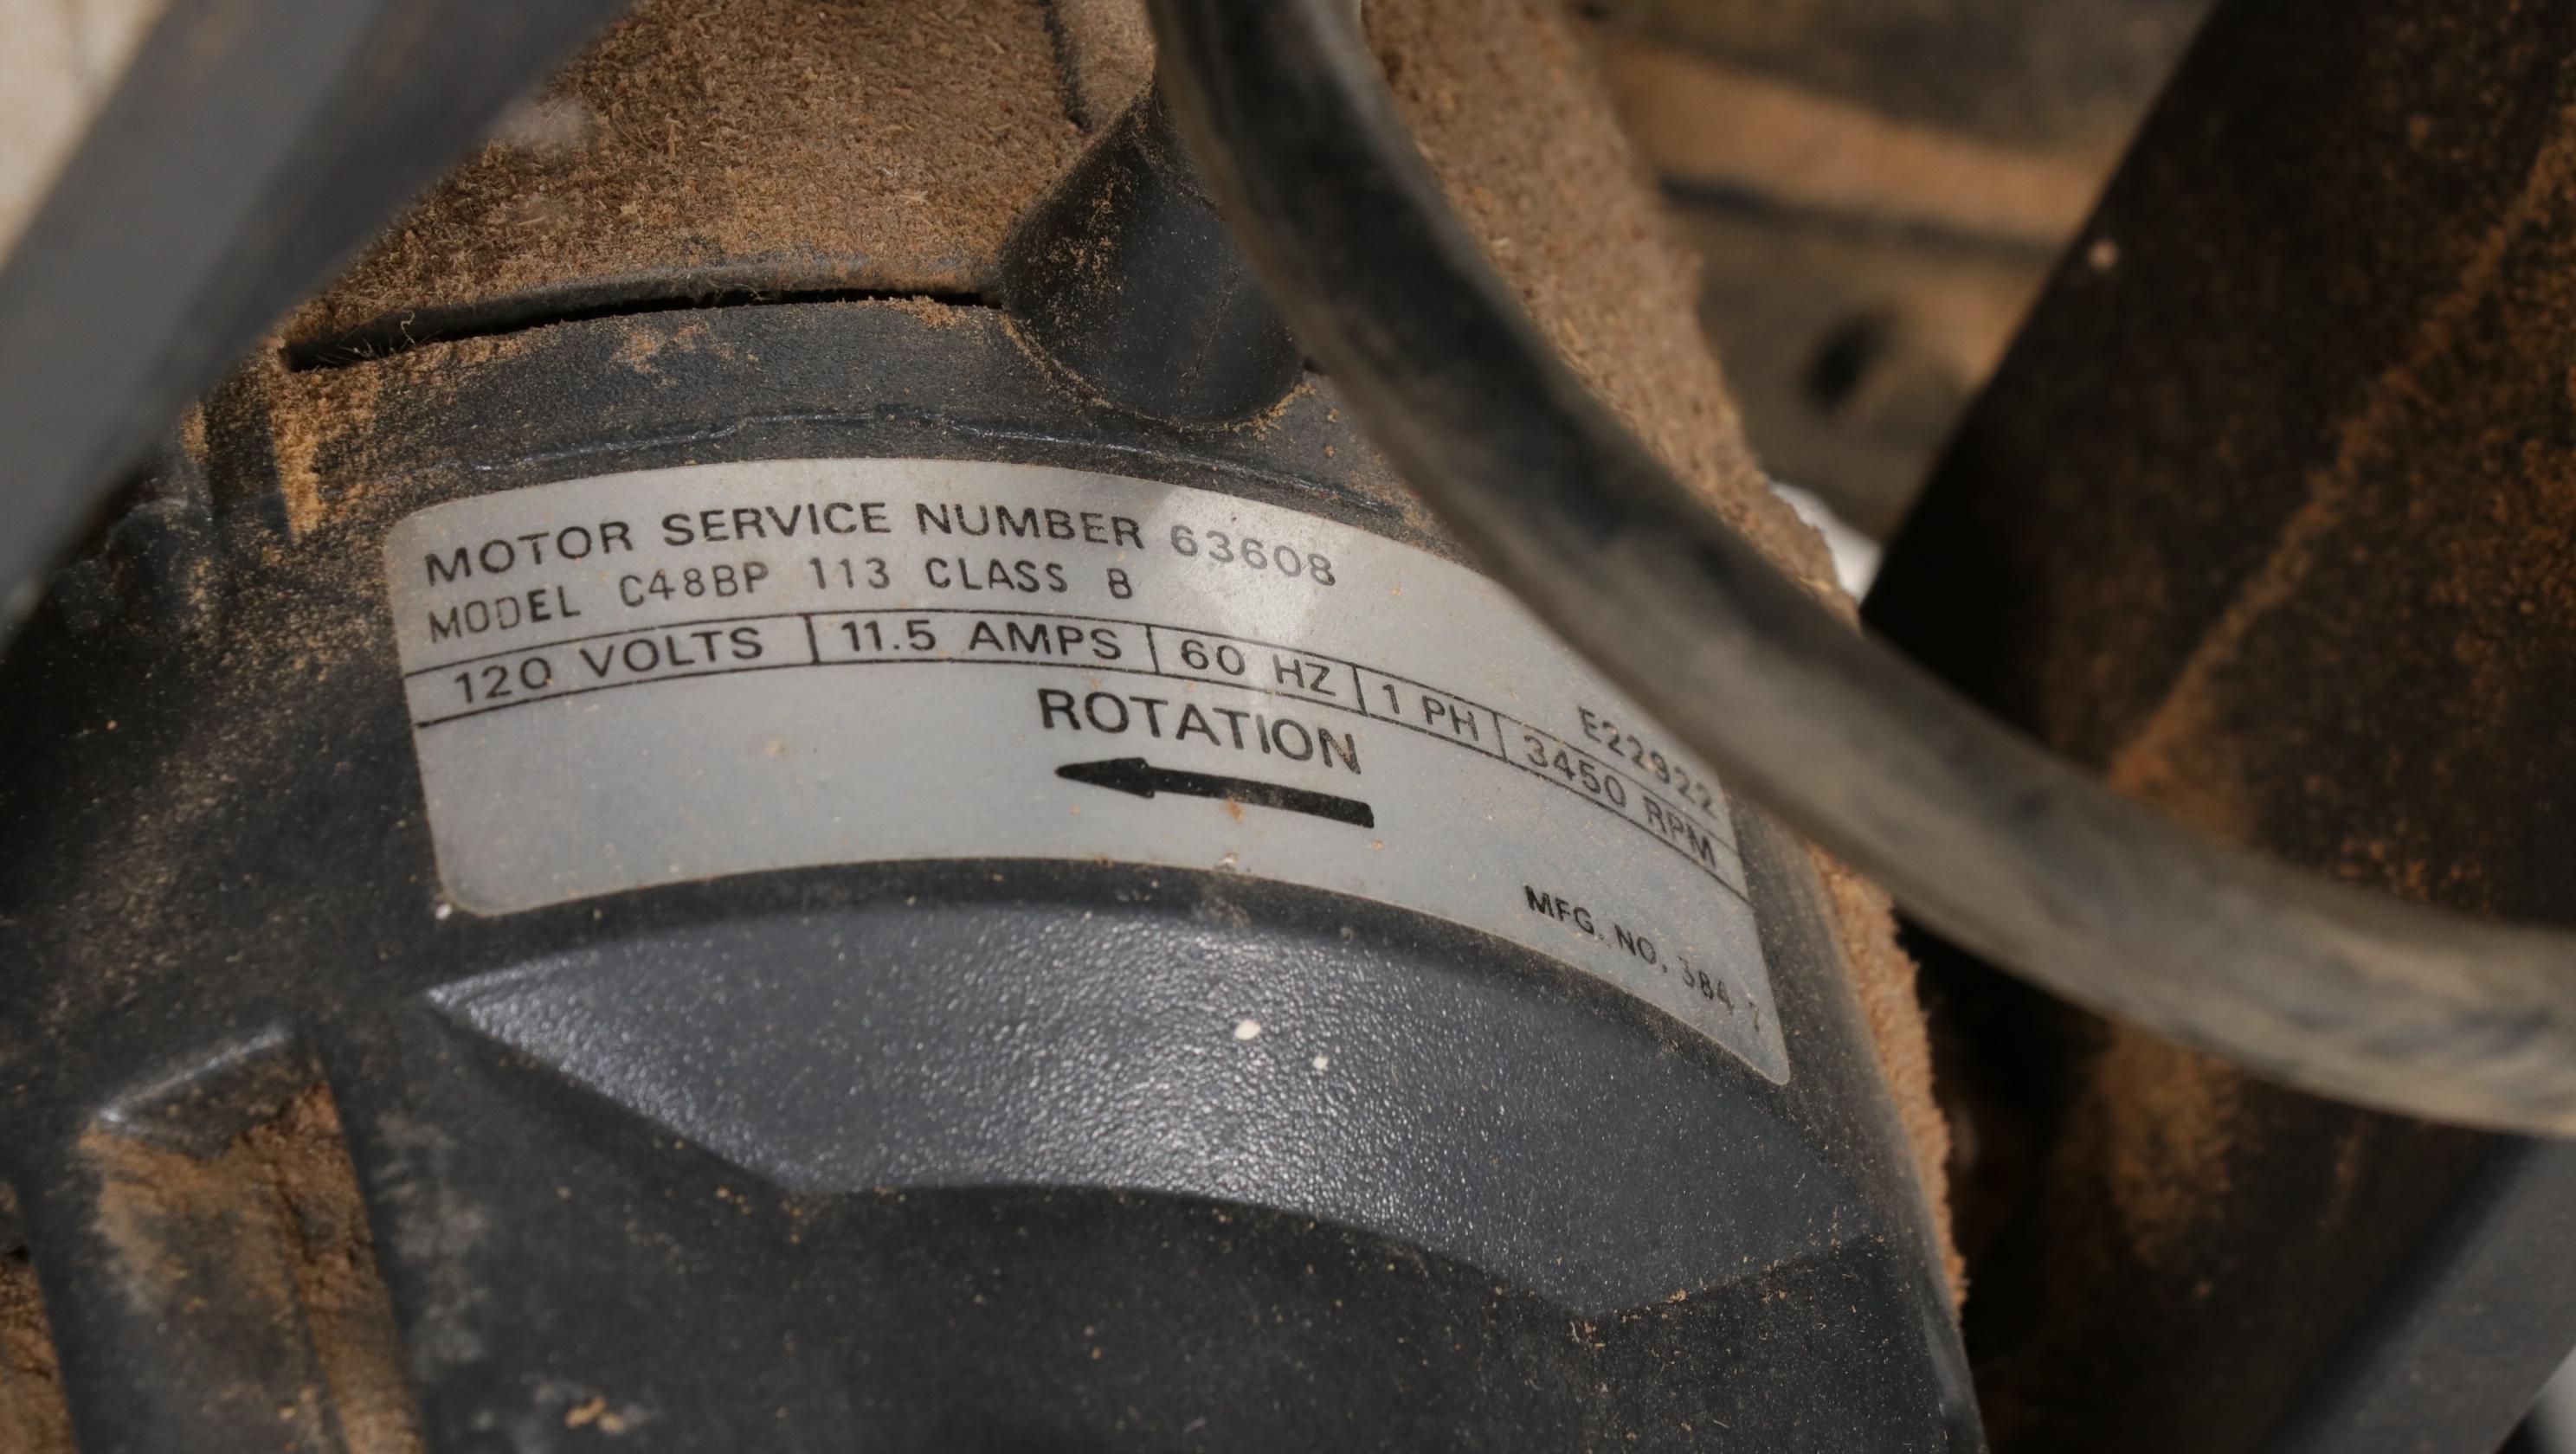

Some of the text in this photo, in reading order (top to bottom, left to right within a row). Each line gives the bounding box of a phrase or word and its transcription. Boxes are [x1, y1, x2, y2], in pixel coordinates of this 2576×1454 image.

[424, 501, 1336, 587] MOTOR SERVICE NUMBER 63608
[428, 557, 1133, 643] MODEL C48BP 113 CLASS B
[454, 620, 1716, 870] 120 VOLTS 11.5 AMPS 60 HZ 1 PH 3450 RPM
[1038, 688, 1361, 775] ROTATION
